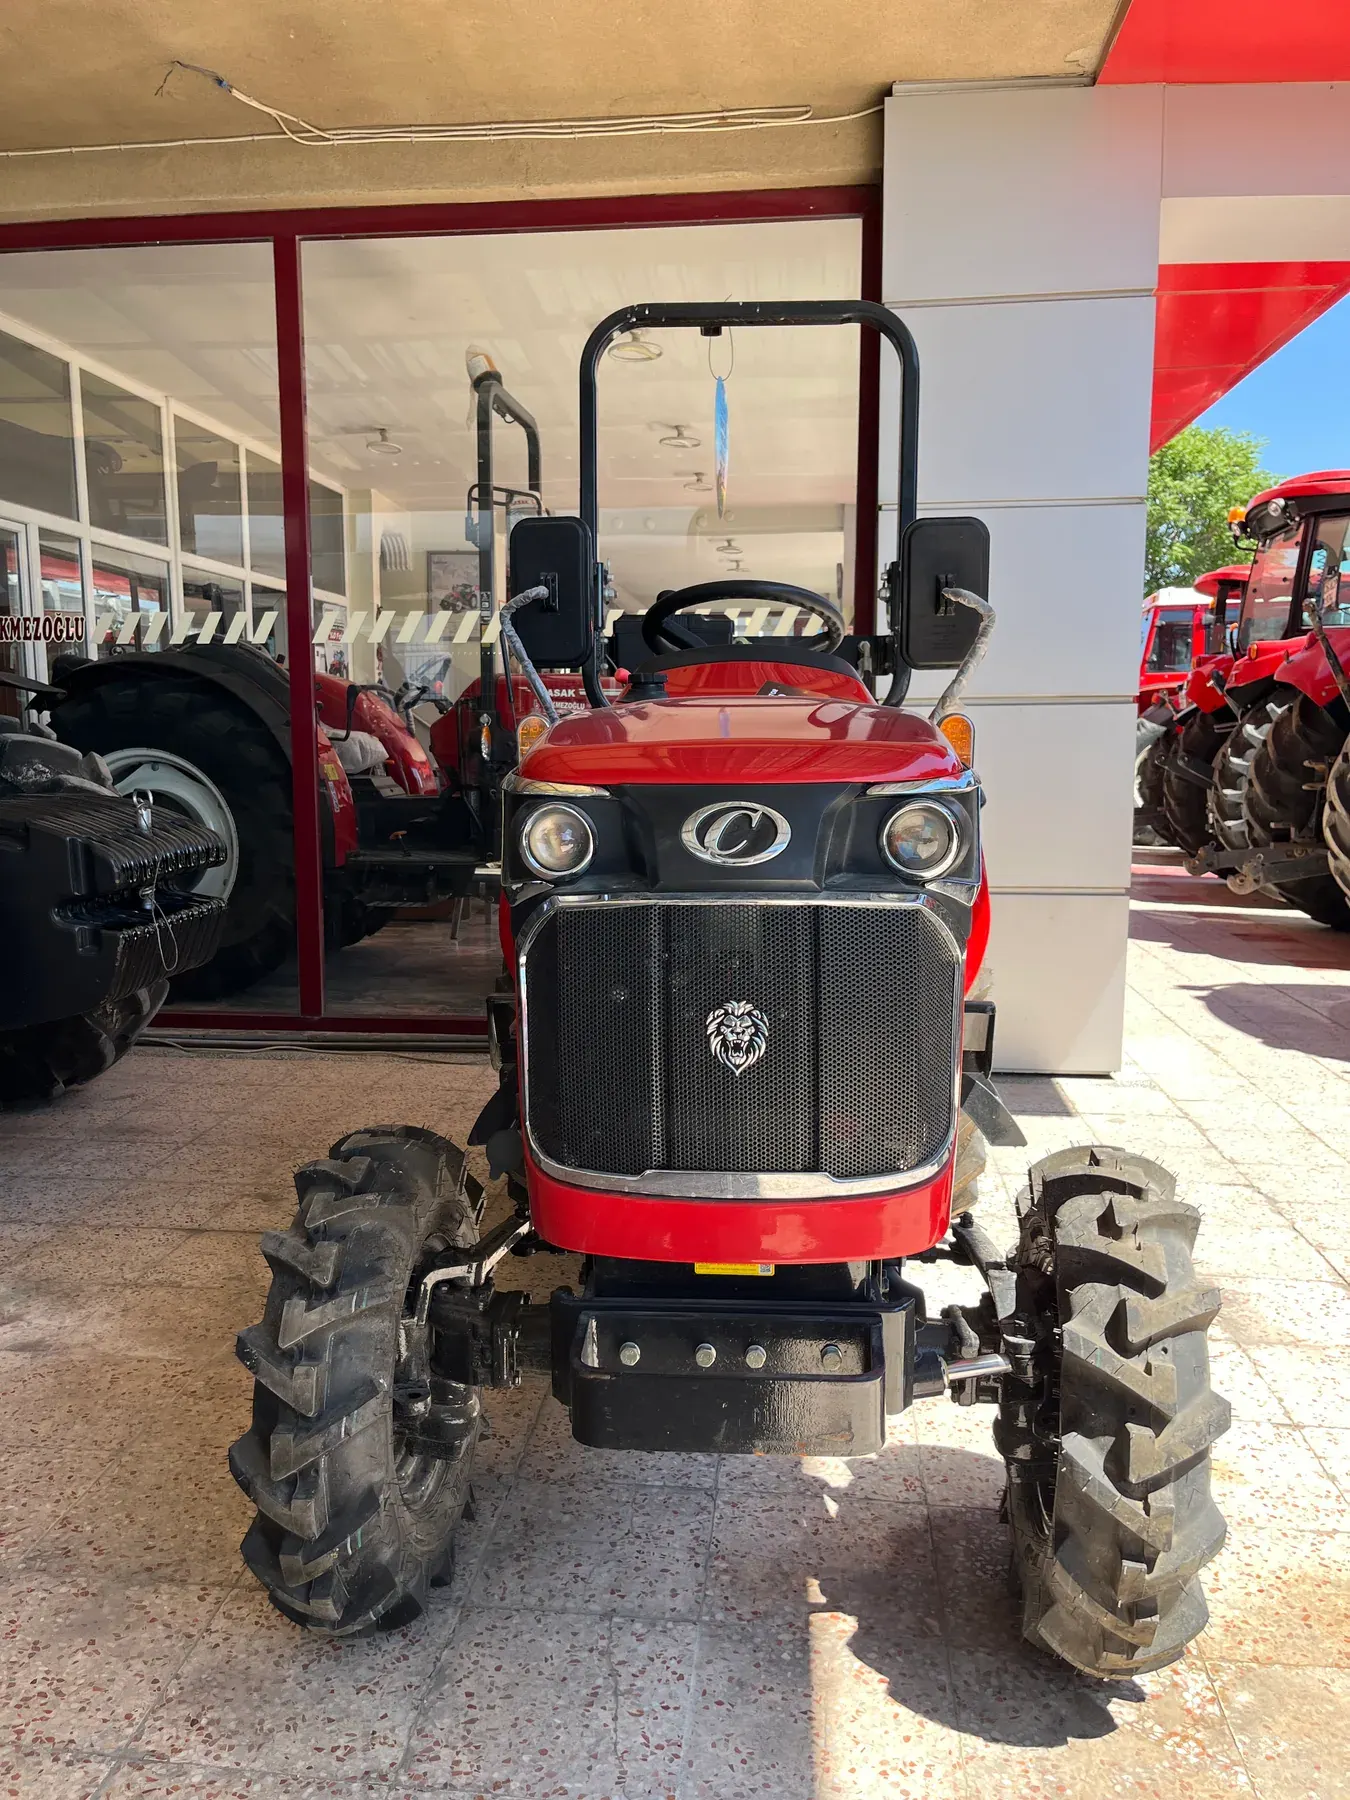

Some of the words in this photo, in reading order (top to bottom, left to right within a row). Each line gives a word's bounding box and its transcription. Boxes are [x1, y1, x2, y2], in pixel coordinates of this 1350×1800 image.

[0, 613, 85, 642] KMEZOĞLU
[548, 688, 575, 697] ASAK
[553, 701, 585, 710] KMEZOĞLU
